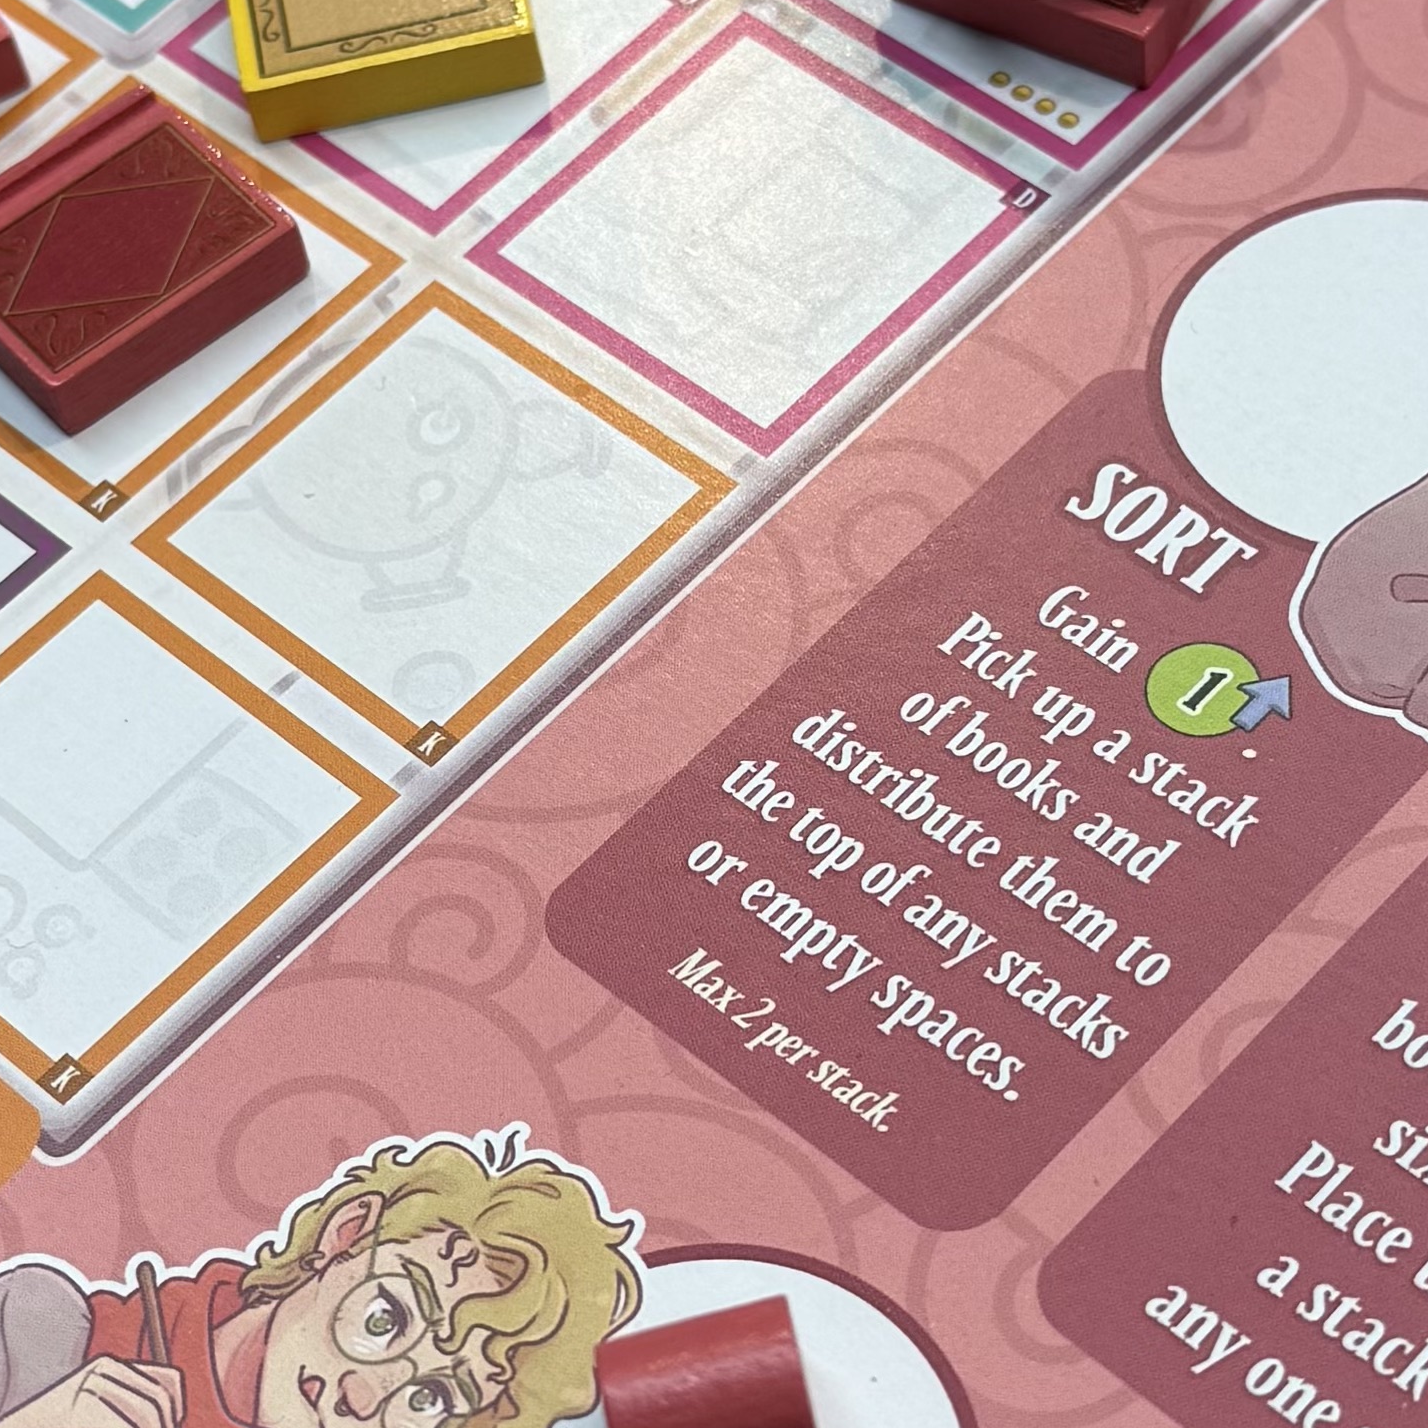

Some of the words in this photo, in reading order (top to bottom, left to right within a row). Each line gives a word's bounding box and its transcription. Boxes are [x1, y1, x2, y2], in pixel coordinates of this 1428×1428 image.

[1013, 191, 1035, 210] D
[90, 490, 117, 512] K
[1064, 463, 1259, 595] SORT
[1038, 584, 1141, 676] Gain
[1181, 668, 1230, 714] 1
[419, 732, 445, 755] K
[937, 611, 1038, 700] Pick
[1032, 683, 1098, 745] up
[1092, 728, 1132, 764] a
[1130, 749, 1259, 850] stack
[900, 689, 952, 738] of
[946, 720, 1078, 824] books
[1073, 807, 1182, 886] and
[791, 709, 1004, 869] distribute
[1000, 848, 1119, 952] them
[1117, 935, 1173, 988] to
[720, 757, 798, 824] the
[790, 807, 865, 880] top
[861, 858, 932, 907] of
[903, 890, 998, 970] any
[984, 948, 1130, 1060] stacks
[668, 950, 747, 1018] Max
[686, 839, 747, 888] or
[740, 873, 884, 996] empty
[870, 970, 1021, 1103] spaces.
[731, 996, 776, 1031] 2
[52, 1066, 79, 1092] K
[750, 1018, 818, 1069] per
[806, 1048, 893, 1132] stack.
[1274, 1140, 1416, 1266] Place
[1256, 1254, 1301, 1296] a
[1143, 1283, 1252, 1375] any
